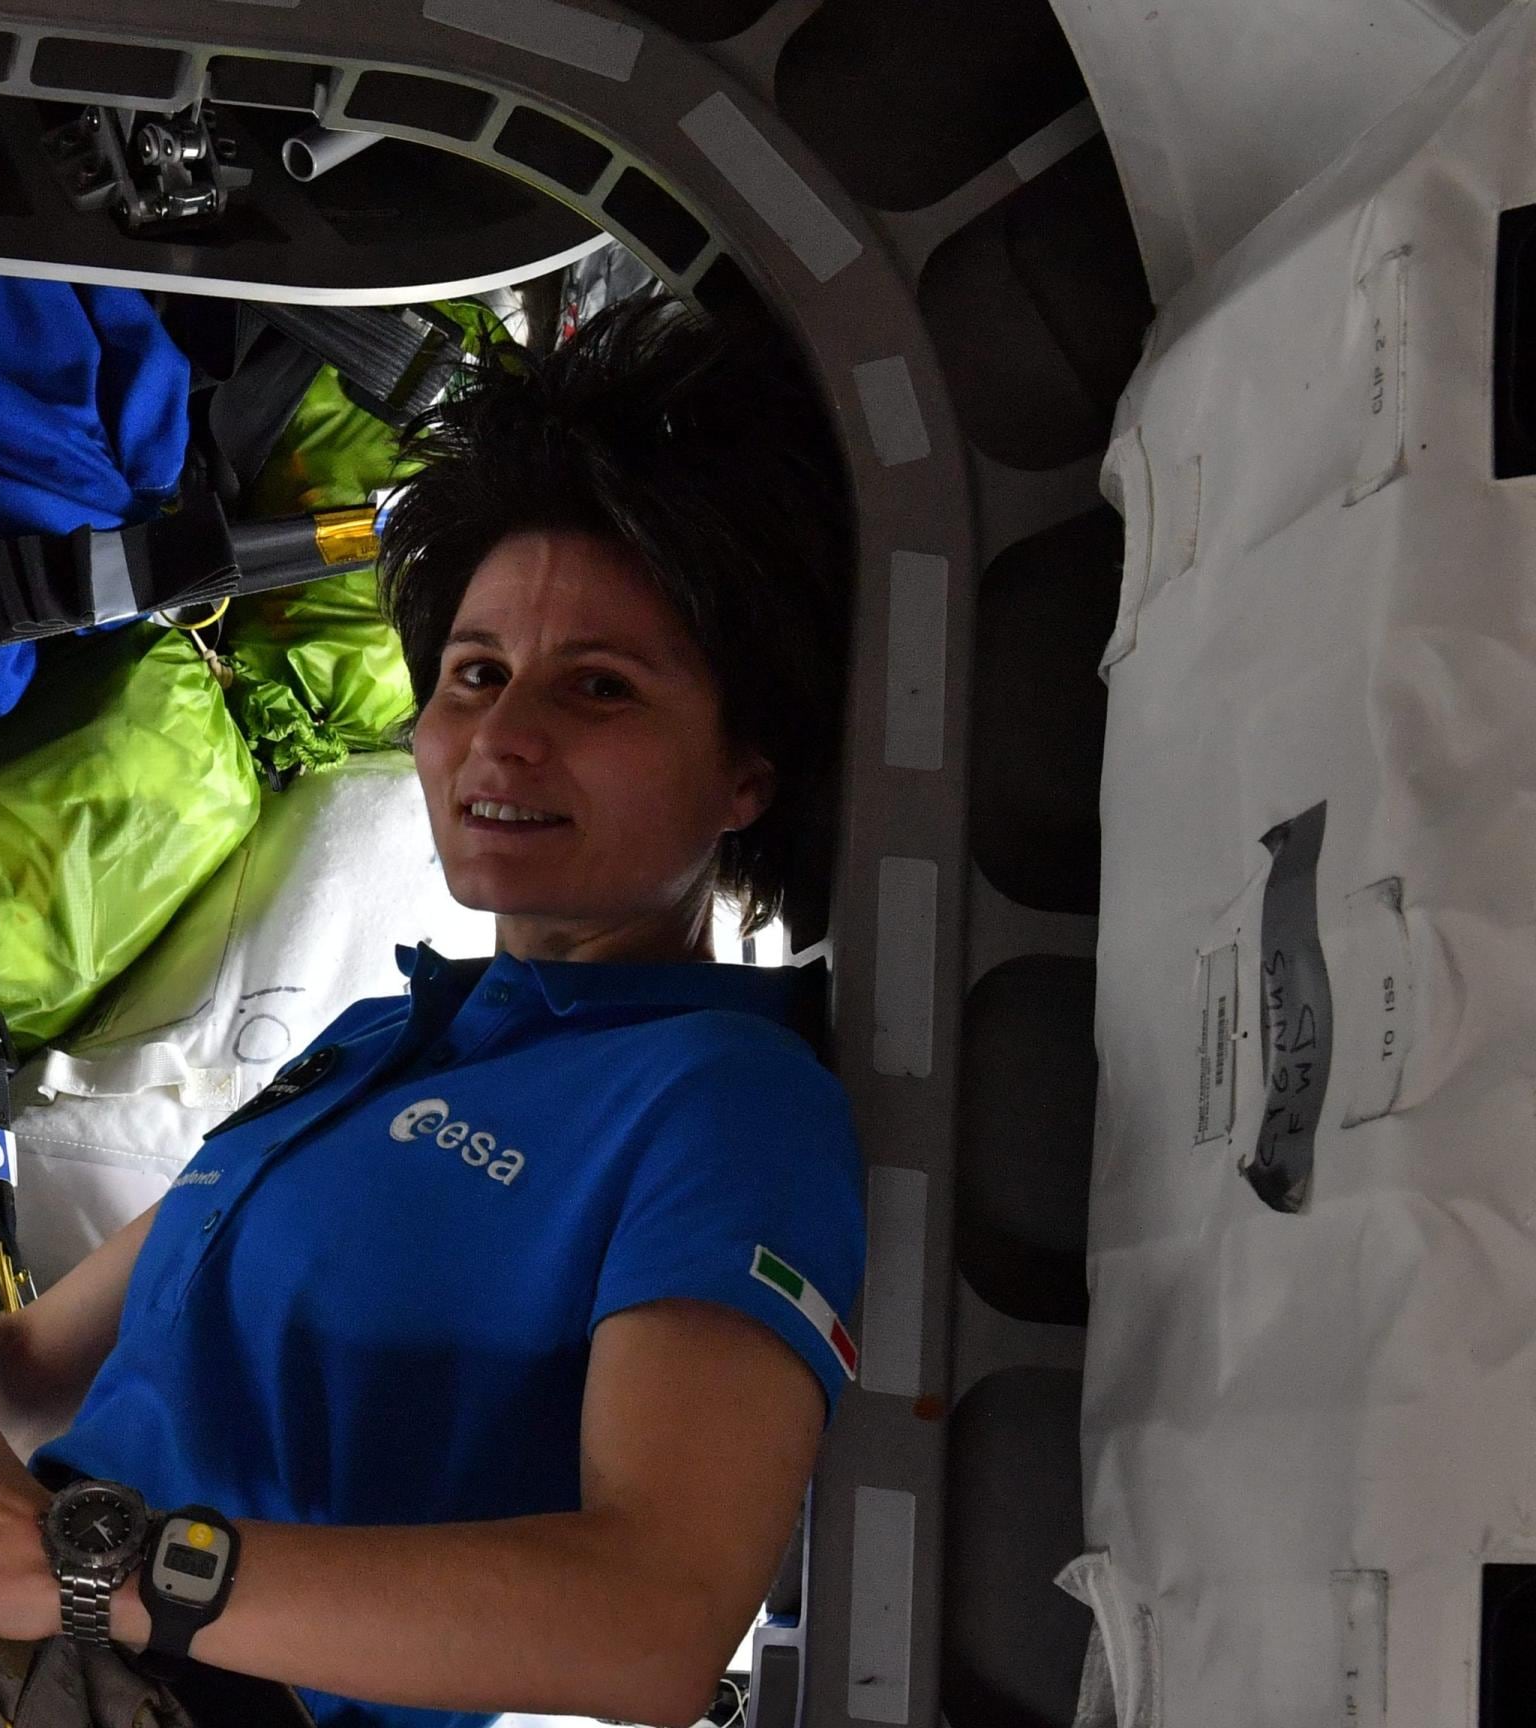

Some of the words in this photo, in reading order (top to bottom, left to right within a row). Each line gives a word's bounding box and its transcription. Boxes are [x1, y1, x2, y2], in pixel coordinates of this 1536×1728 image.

[1382, 976, 1394, 1018] ISS
[1258, 949, 1289, 1167] CYGNUS
[1287, 1004, 1316, 1136] FWD
[1381, 1030, 1394, 1061] TO
